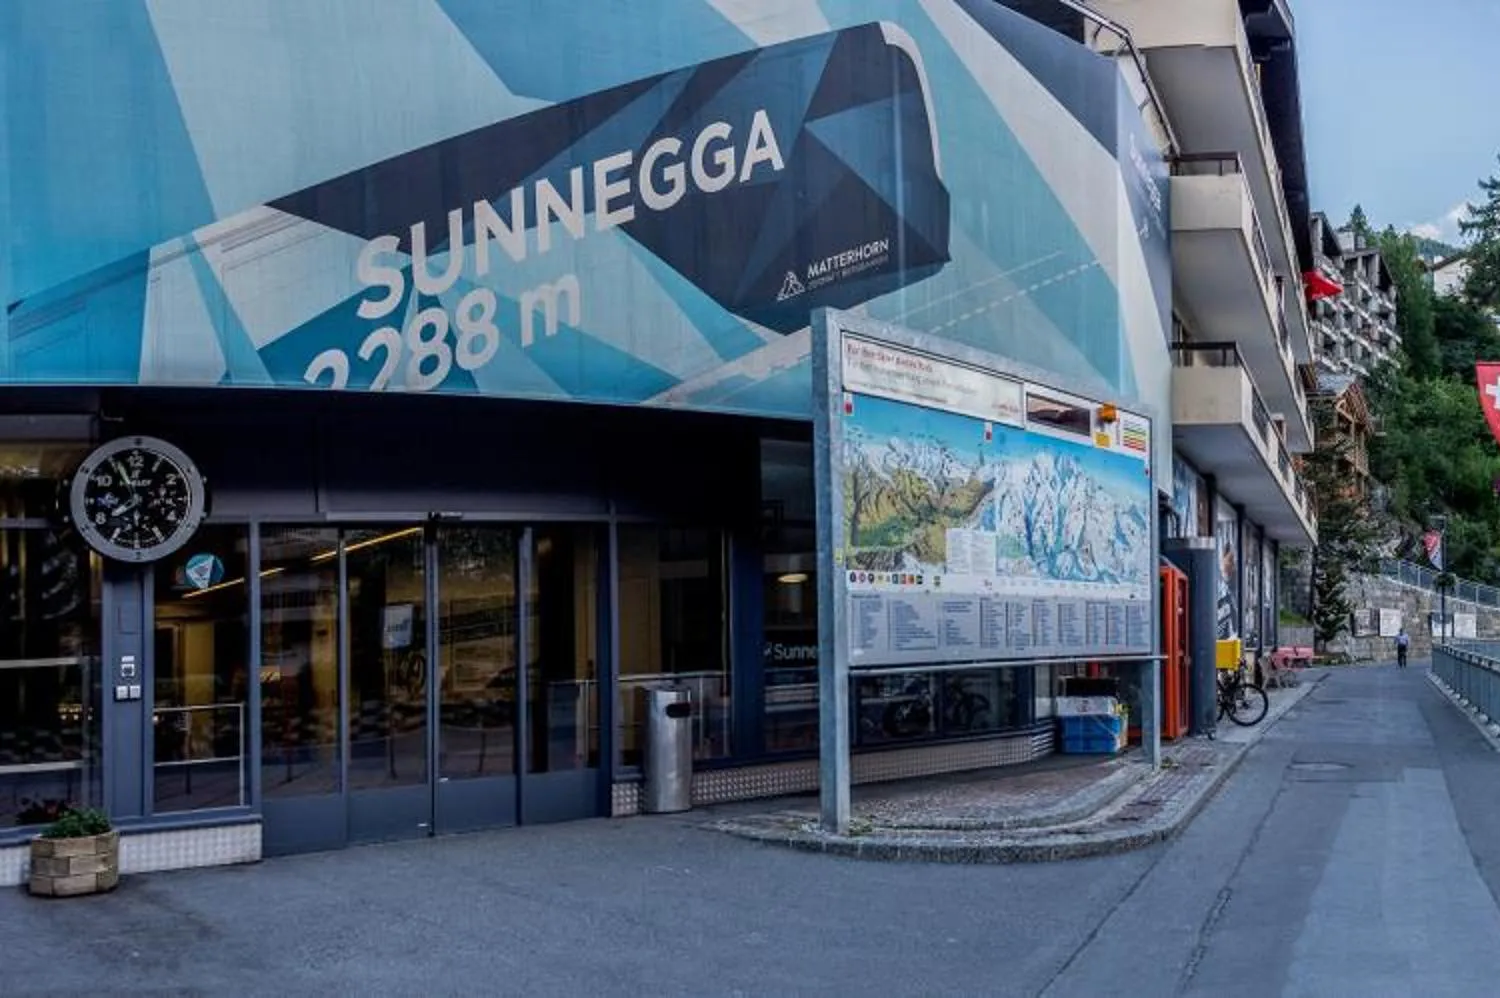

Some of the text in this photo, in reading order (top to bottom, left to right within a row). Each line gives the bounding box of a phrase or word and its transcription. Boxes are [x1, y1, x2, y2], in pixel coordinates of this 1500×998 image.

[355, 108, 784, 320] SUNNEGGA
[807, 239, 889, 279] MATTERHORN
[520, 272, 582, 348] m
[96, 474, 176, 487] 10 2
[95, 511, 106, 525] 8
